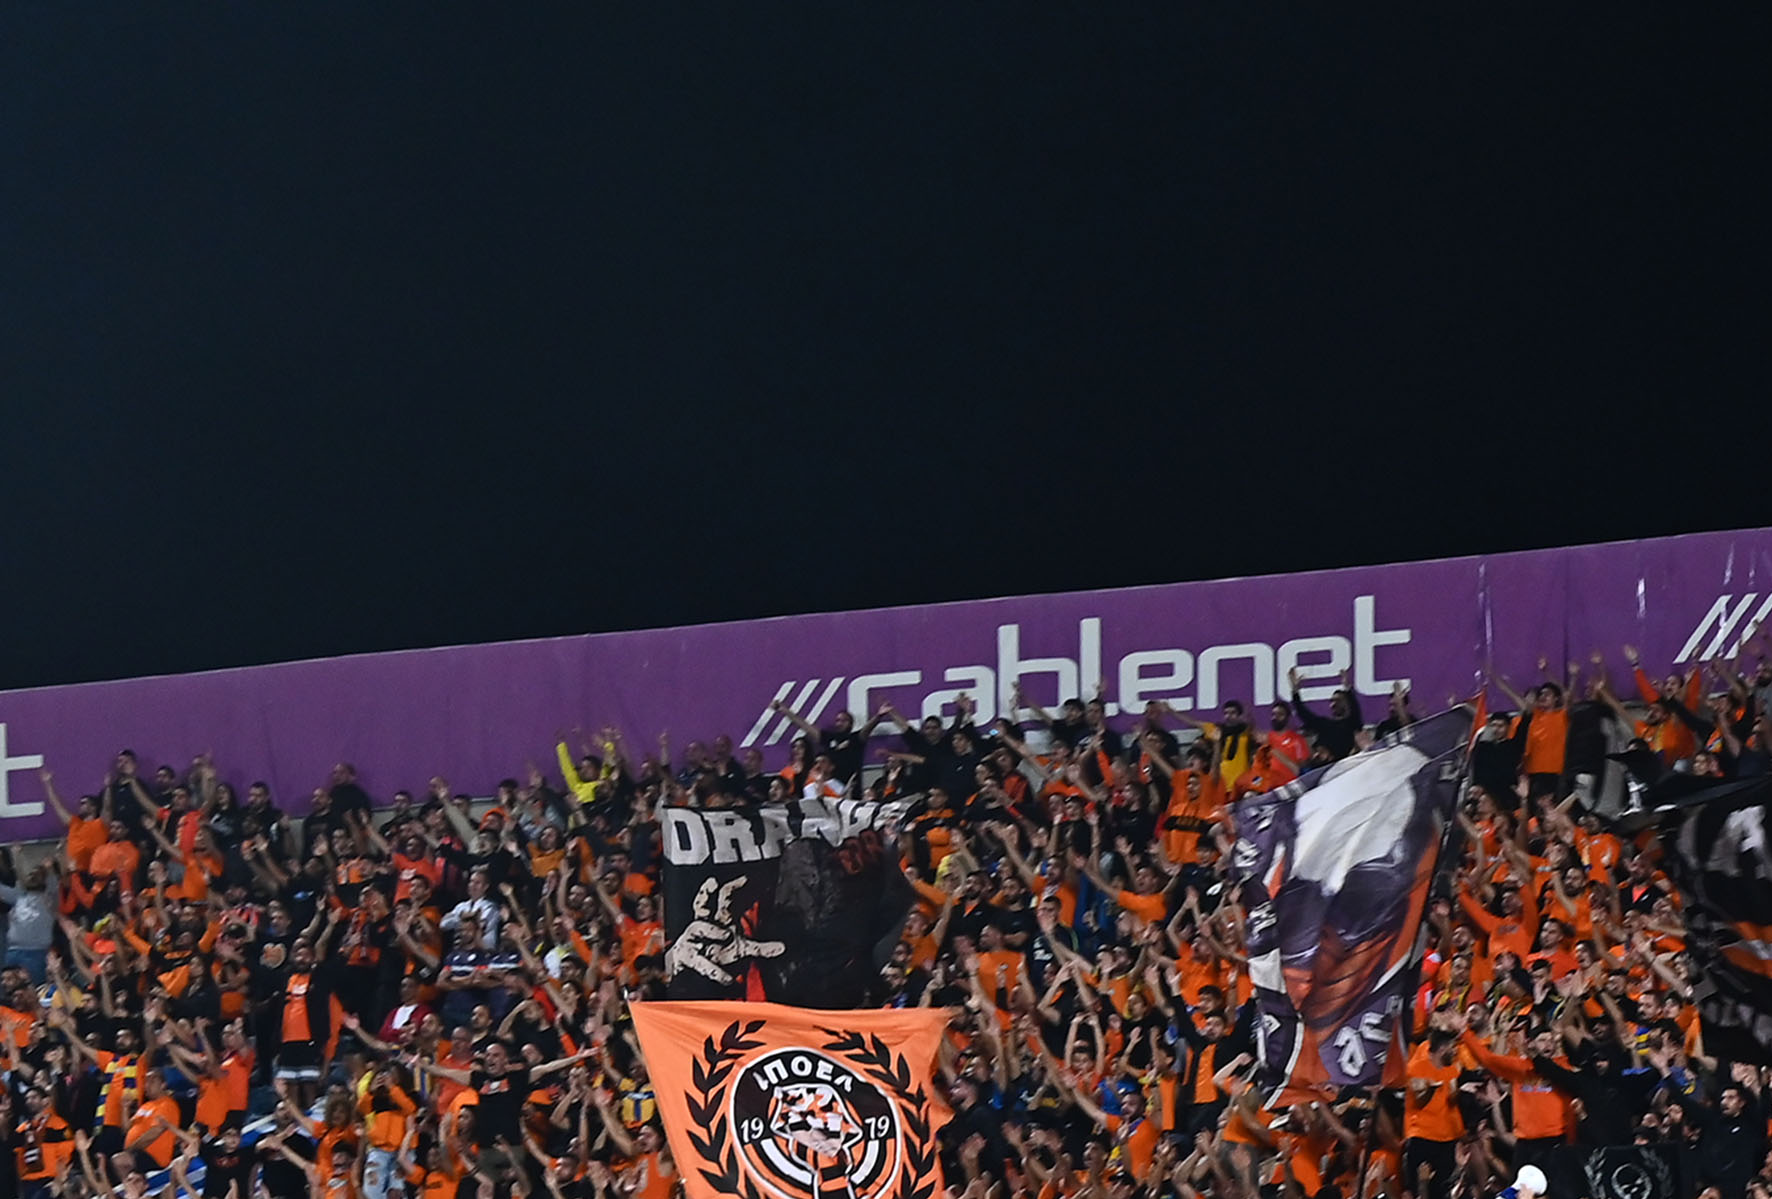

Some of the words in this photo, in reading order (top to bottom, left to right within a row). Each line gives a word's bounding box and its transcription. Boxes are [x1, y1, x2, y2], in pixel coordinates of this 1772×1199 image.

[843, 595, 1411, 731] cablenet
[741, 1117, 765, 1143] 19
[865, 1115, 890, 1140] 79
